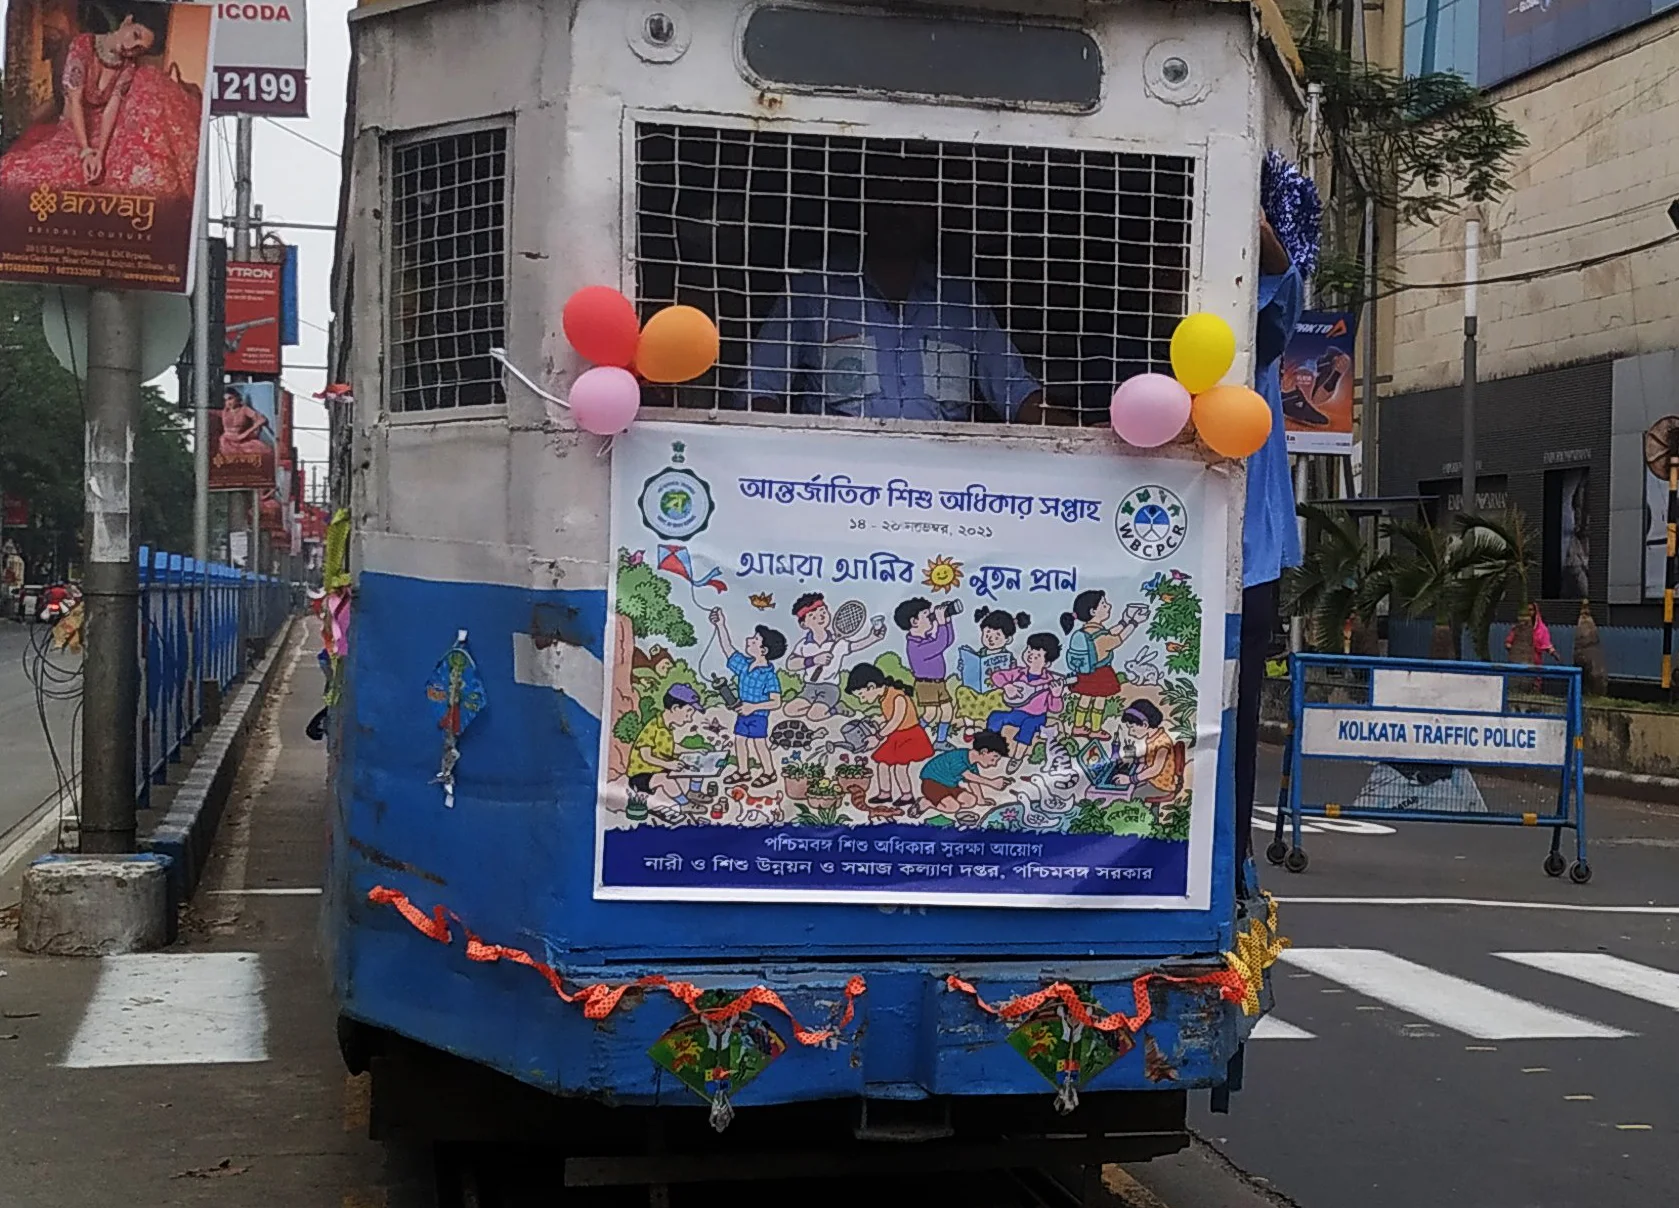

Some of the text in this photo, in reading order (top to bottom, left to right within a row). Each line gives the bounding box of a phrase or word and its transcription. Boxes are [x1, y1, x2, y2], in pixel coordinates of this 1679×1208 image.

[217, 3, 291, 22] ICODA
[61, 190, 157, 231] anvay
[739, 474, 1102, 523] আন্তর্জাতিক শিশু অধিকার সপ্তাহ
[958, 525, 993, 537] ২০২১
[736, 552, 824, 584] আমরা
[1337, 720, 1537, 749] KOLKATA TRAFFIC POLICE
[764, 833, 833, 852] পশ্চিমবঙ্গ
[838, 834, 869, 852] শিশু
[873, 836, 937, 855] অধিকার
[940, 841, 985, 858] সুরক্ষা
[643, 856, 683, 872] নারী
[690, 859, 706, 872] ও
[712, 855, 749, 873] শিশু
[820, 861, 835, 874] ও
[840, 861, 893, 876] সমাজ
[898, 863, 954, 877] কল্যাণ
[1012, 862, 1089, 881] পশ্চিমবঙ্গ
[1096, 866, 1155, 881] সরকার
